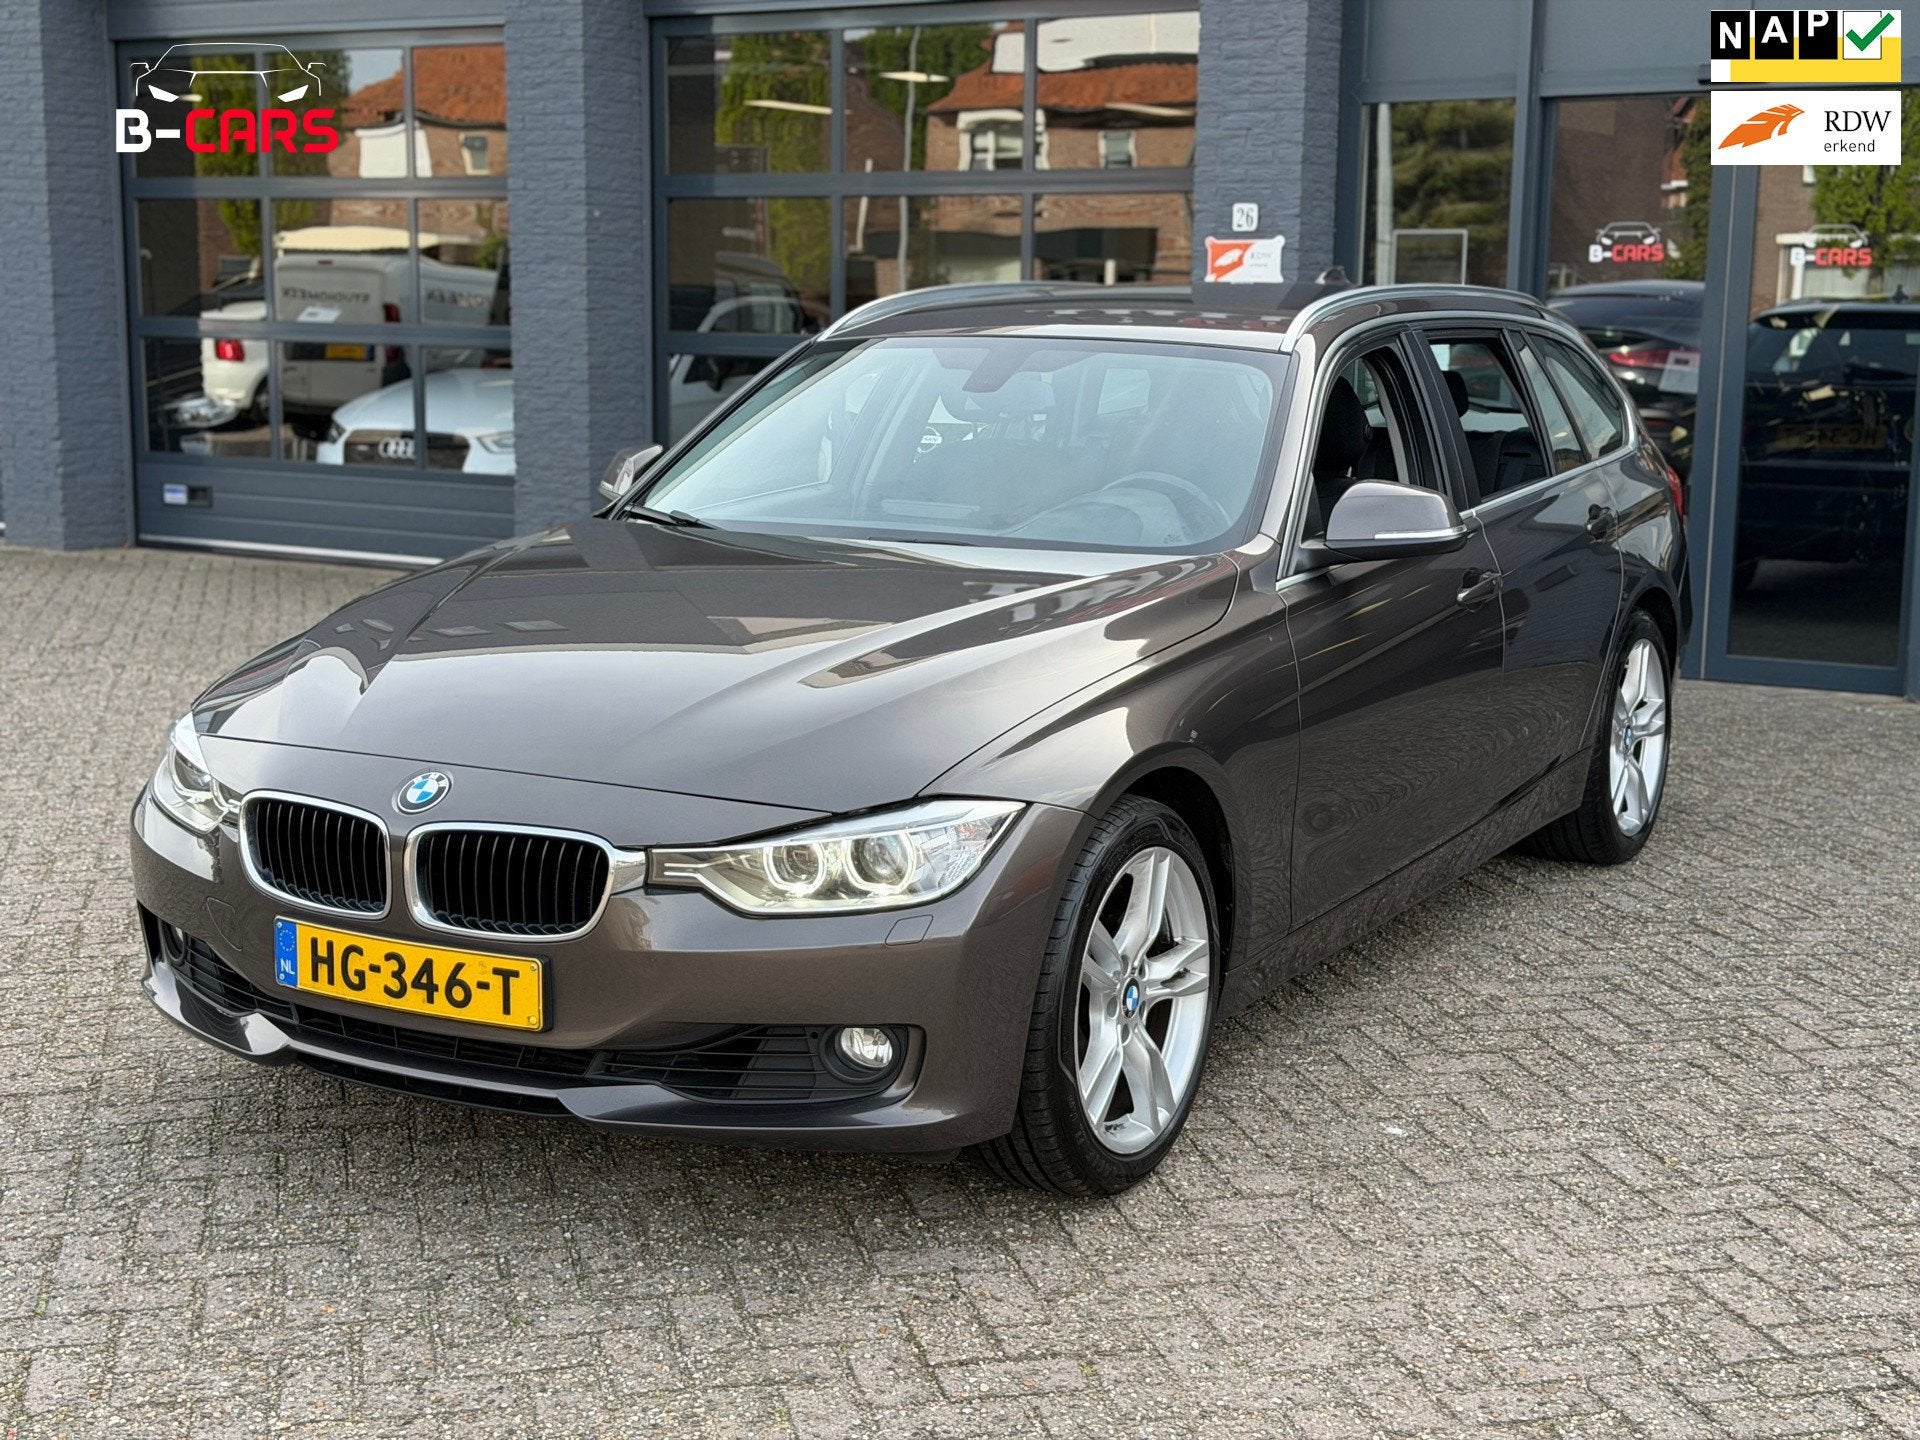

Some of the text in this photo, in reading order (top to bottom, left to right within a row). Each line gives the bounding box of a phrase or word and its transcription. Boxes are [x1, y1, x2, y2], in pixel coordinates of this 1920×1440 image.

[1236, 207, 1254, 228] 26
[1588, 244, 1664, 263] B-CARS
[1790, 247, 1872, 266] B-CARS
[280, 959, 296, 975] NL
[310, 936, 520, 1016] HG-346-T
